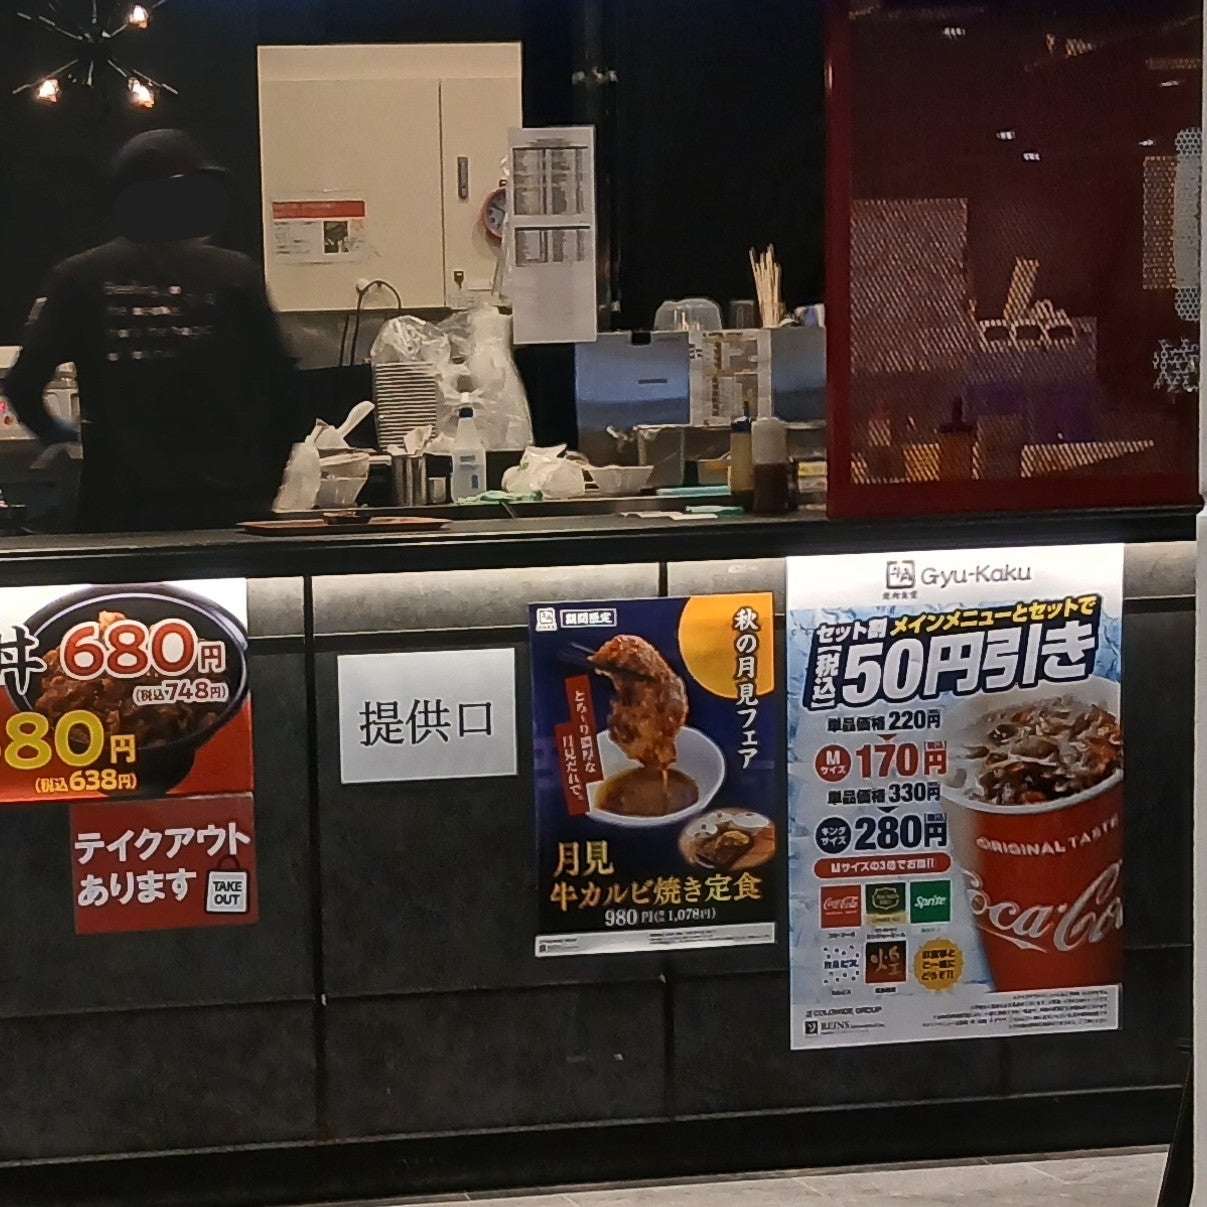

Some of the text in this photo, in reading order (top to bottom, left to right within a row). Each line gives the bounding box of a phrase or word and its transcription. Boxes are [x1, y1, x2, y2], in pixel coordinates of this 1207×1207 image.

[920, 563, 1032, 589] Gyu-Kaku
[890, 595, 1098, 637] メインメニューとセットで
[61, 620, 225, 679] 680円
[842, 619, 1096, 705] 50円引き
[734, 607, 760, 770] 秋の月見フェア
[358, 697, 493, 747] 提供口
[826, 750, 841, 766] M
[855, 742, 948, 779] 170円
[34, 768, 139, 794] (税込638円)
[74, 821, 252, 866] テイクアウト
[854, 814, 948, 850] 280円
[976, 836, 1067, 856] ORIGINAL
[554, 840, 615, 878] 月見
[77, 867, 198, 907] あります
[212, 880, 243, 892] TAKE
[213, 893, 241, 905] OUT
[550, 871, 763, 913] 牛カルビ焼き定食
[914, 895, 946, 910] Sprite
